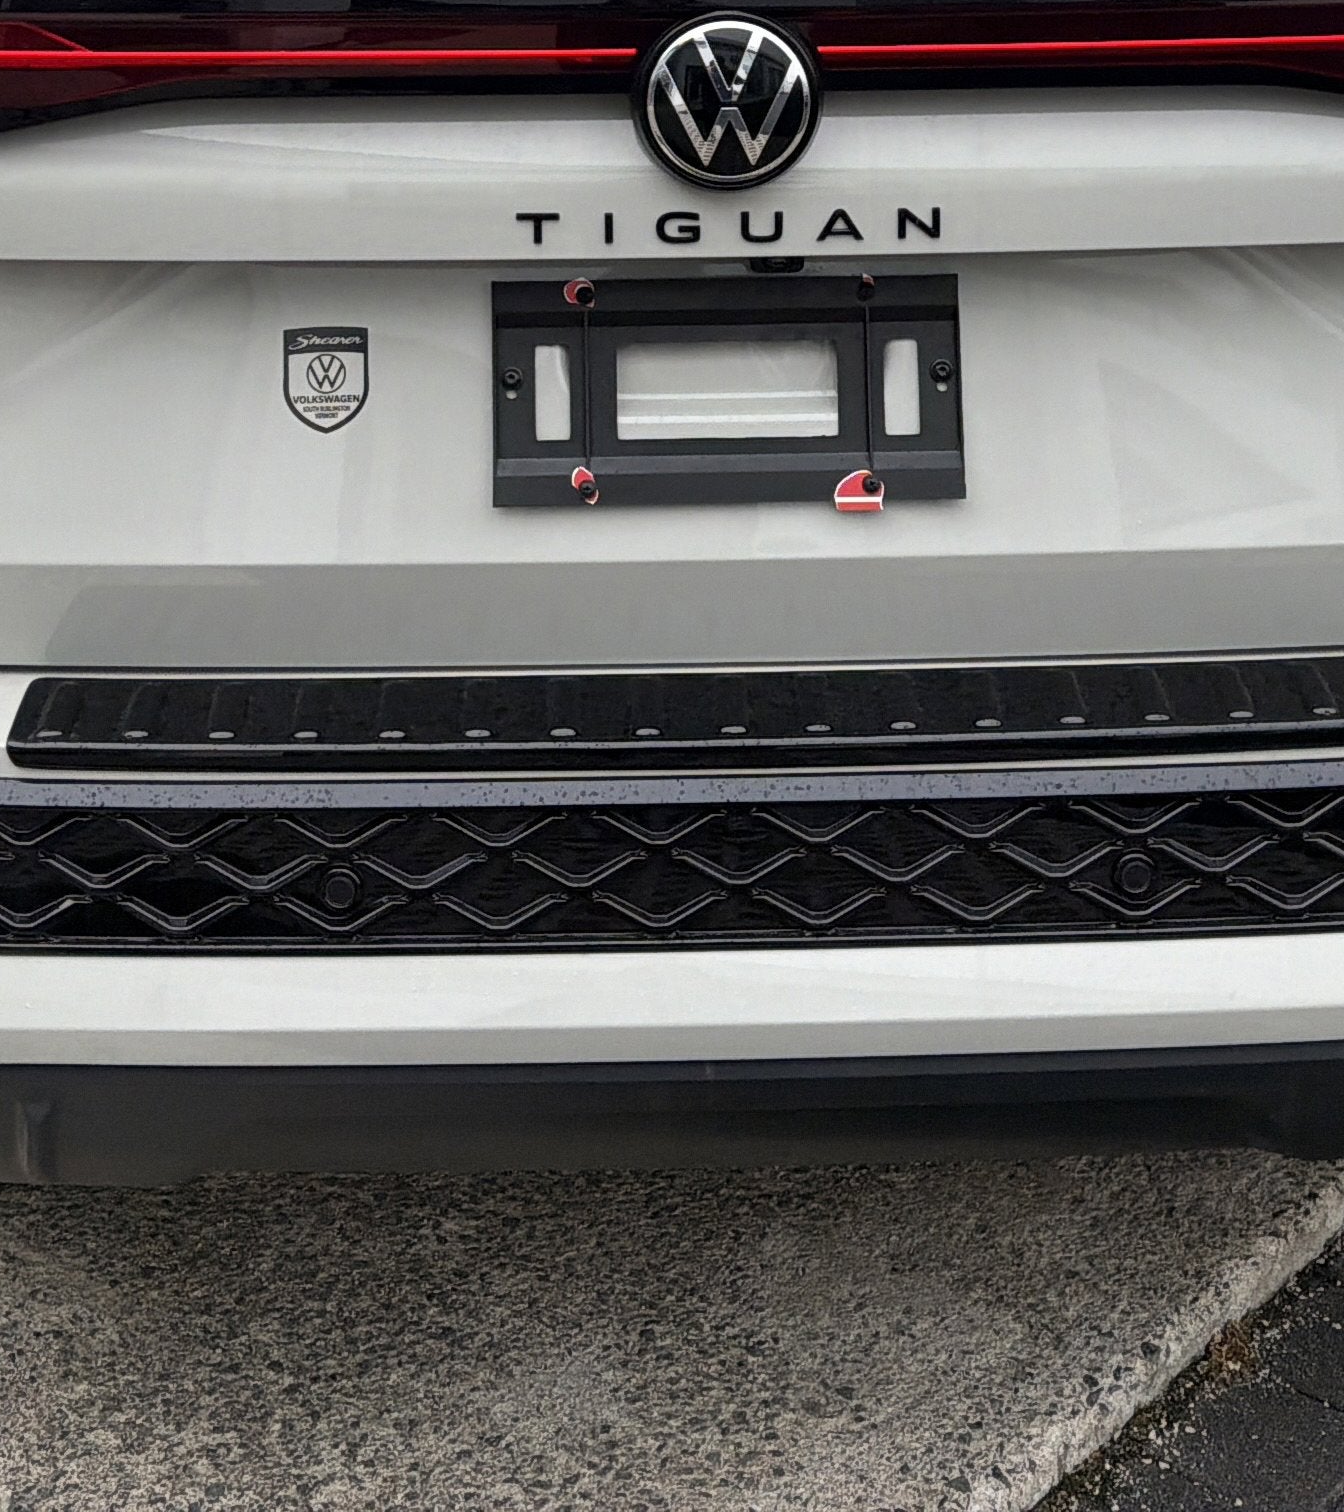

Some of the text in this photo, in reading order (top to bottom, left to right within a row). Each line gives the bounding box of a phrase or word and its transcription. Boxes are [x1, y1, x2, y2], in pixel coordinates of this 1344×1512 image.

[515, 206, 942, 246] TIGUAN
[288, 333, 364, 351] Shearer
[292, 394, 360, 405] VOLKSWAGEN
